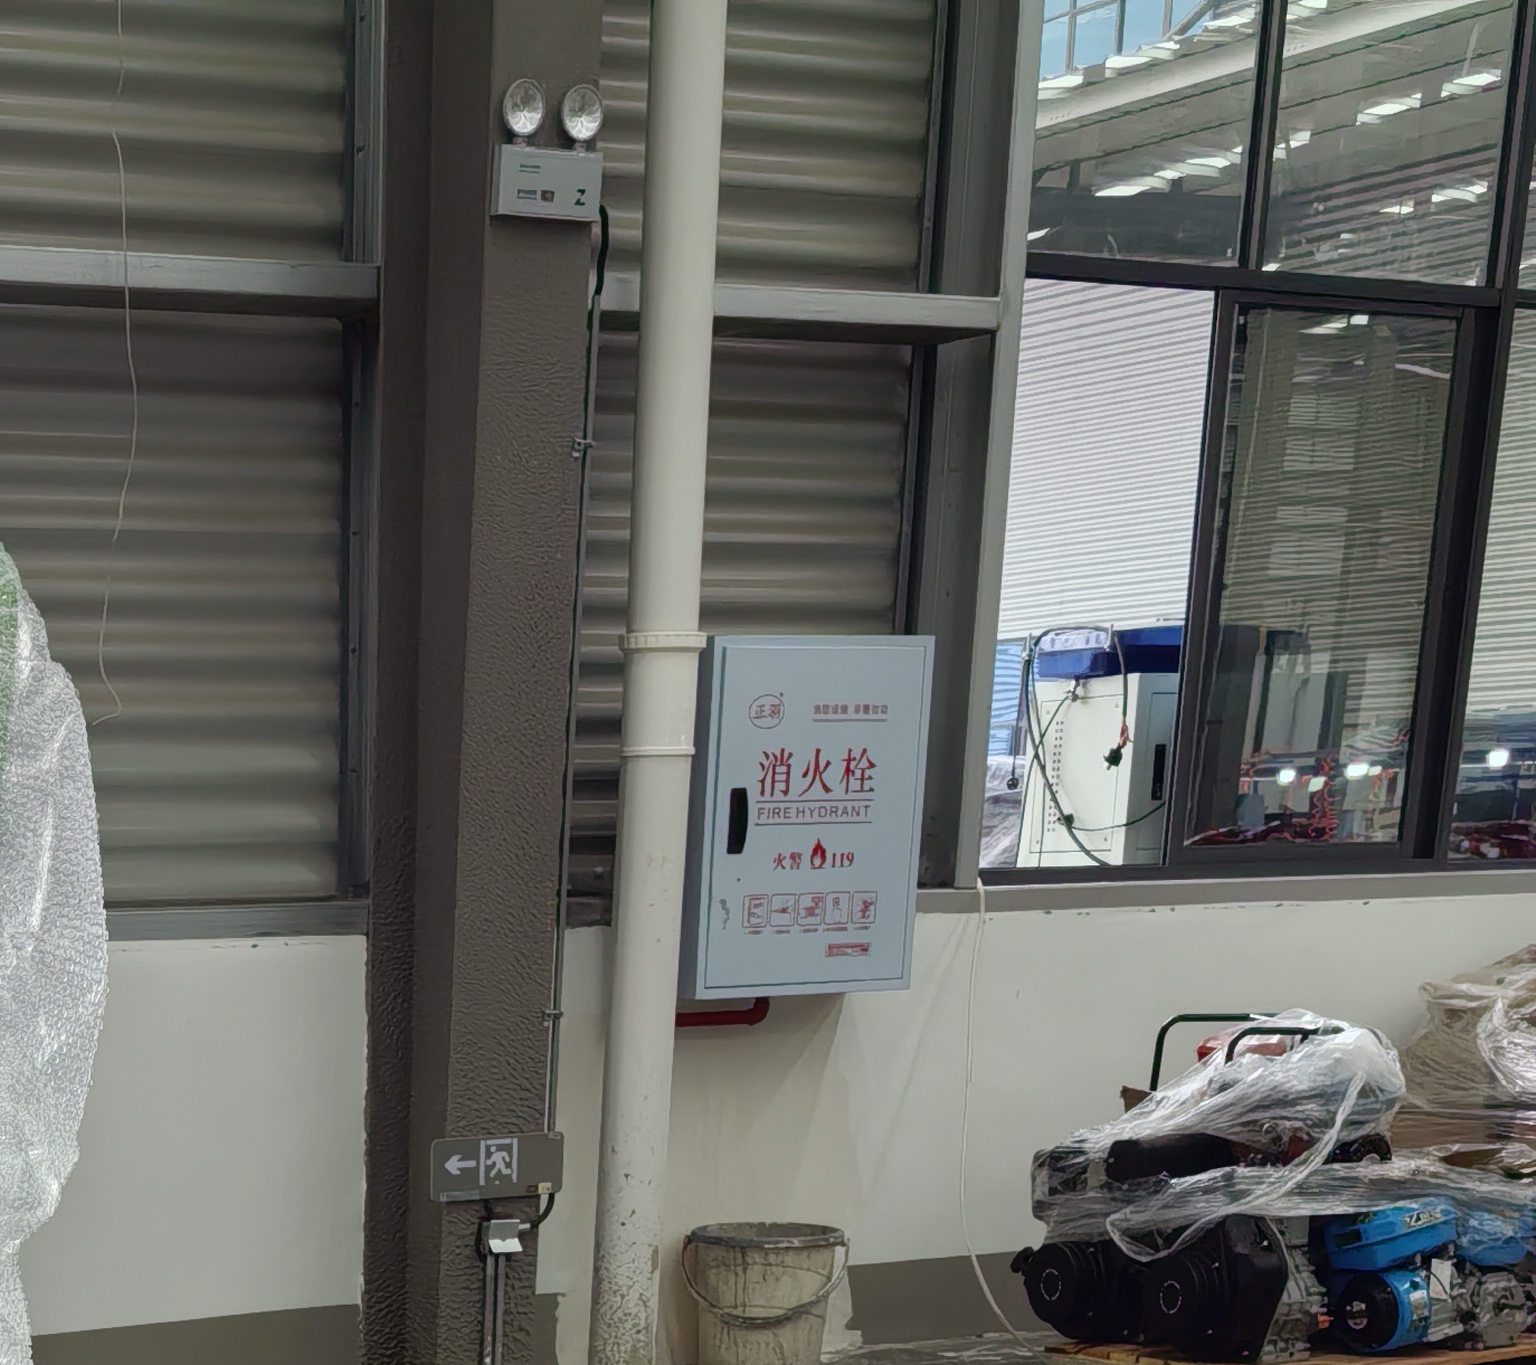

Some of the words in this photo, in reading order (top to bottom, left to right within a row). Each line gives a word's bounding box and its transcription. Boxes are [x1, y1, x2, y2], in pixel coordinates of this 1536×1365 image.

[757, 747, 877, 798] 消火栓
[757, 806, 792, 820] FIRE
[796, 804, 871, 820] HYDRANT
[831, 851, 855, 868] 119
